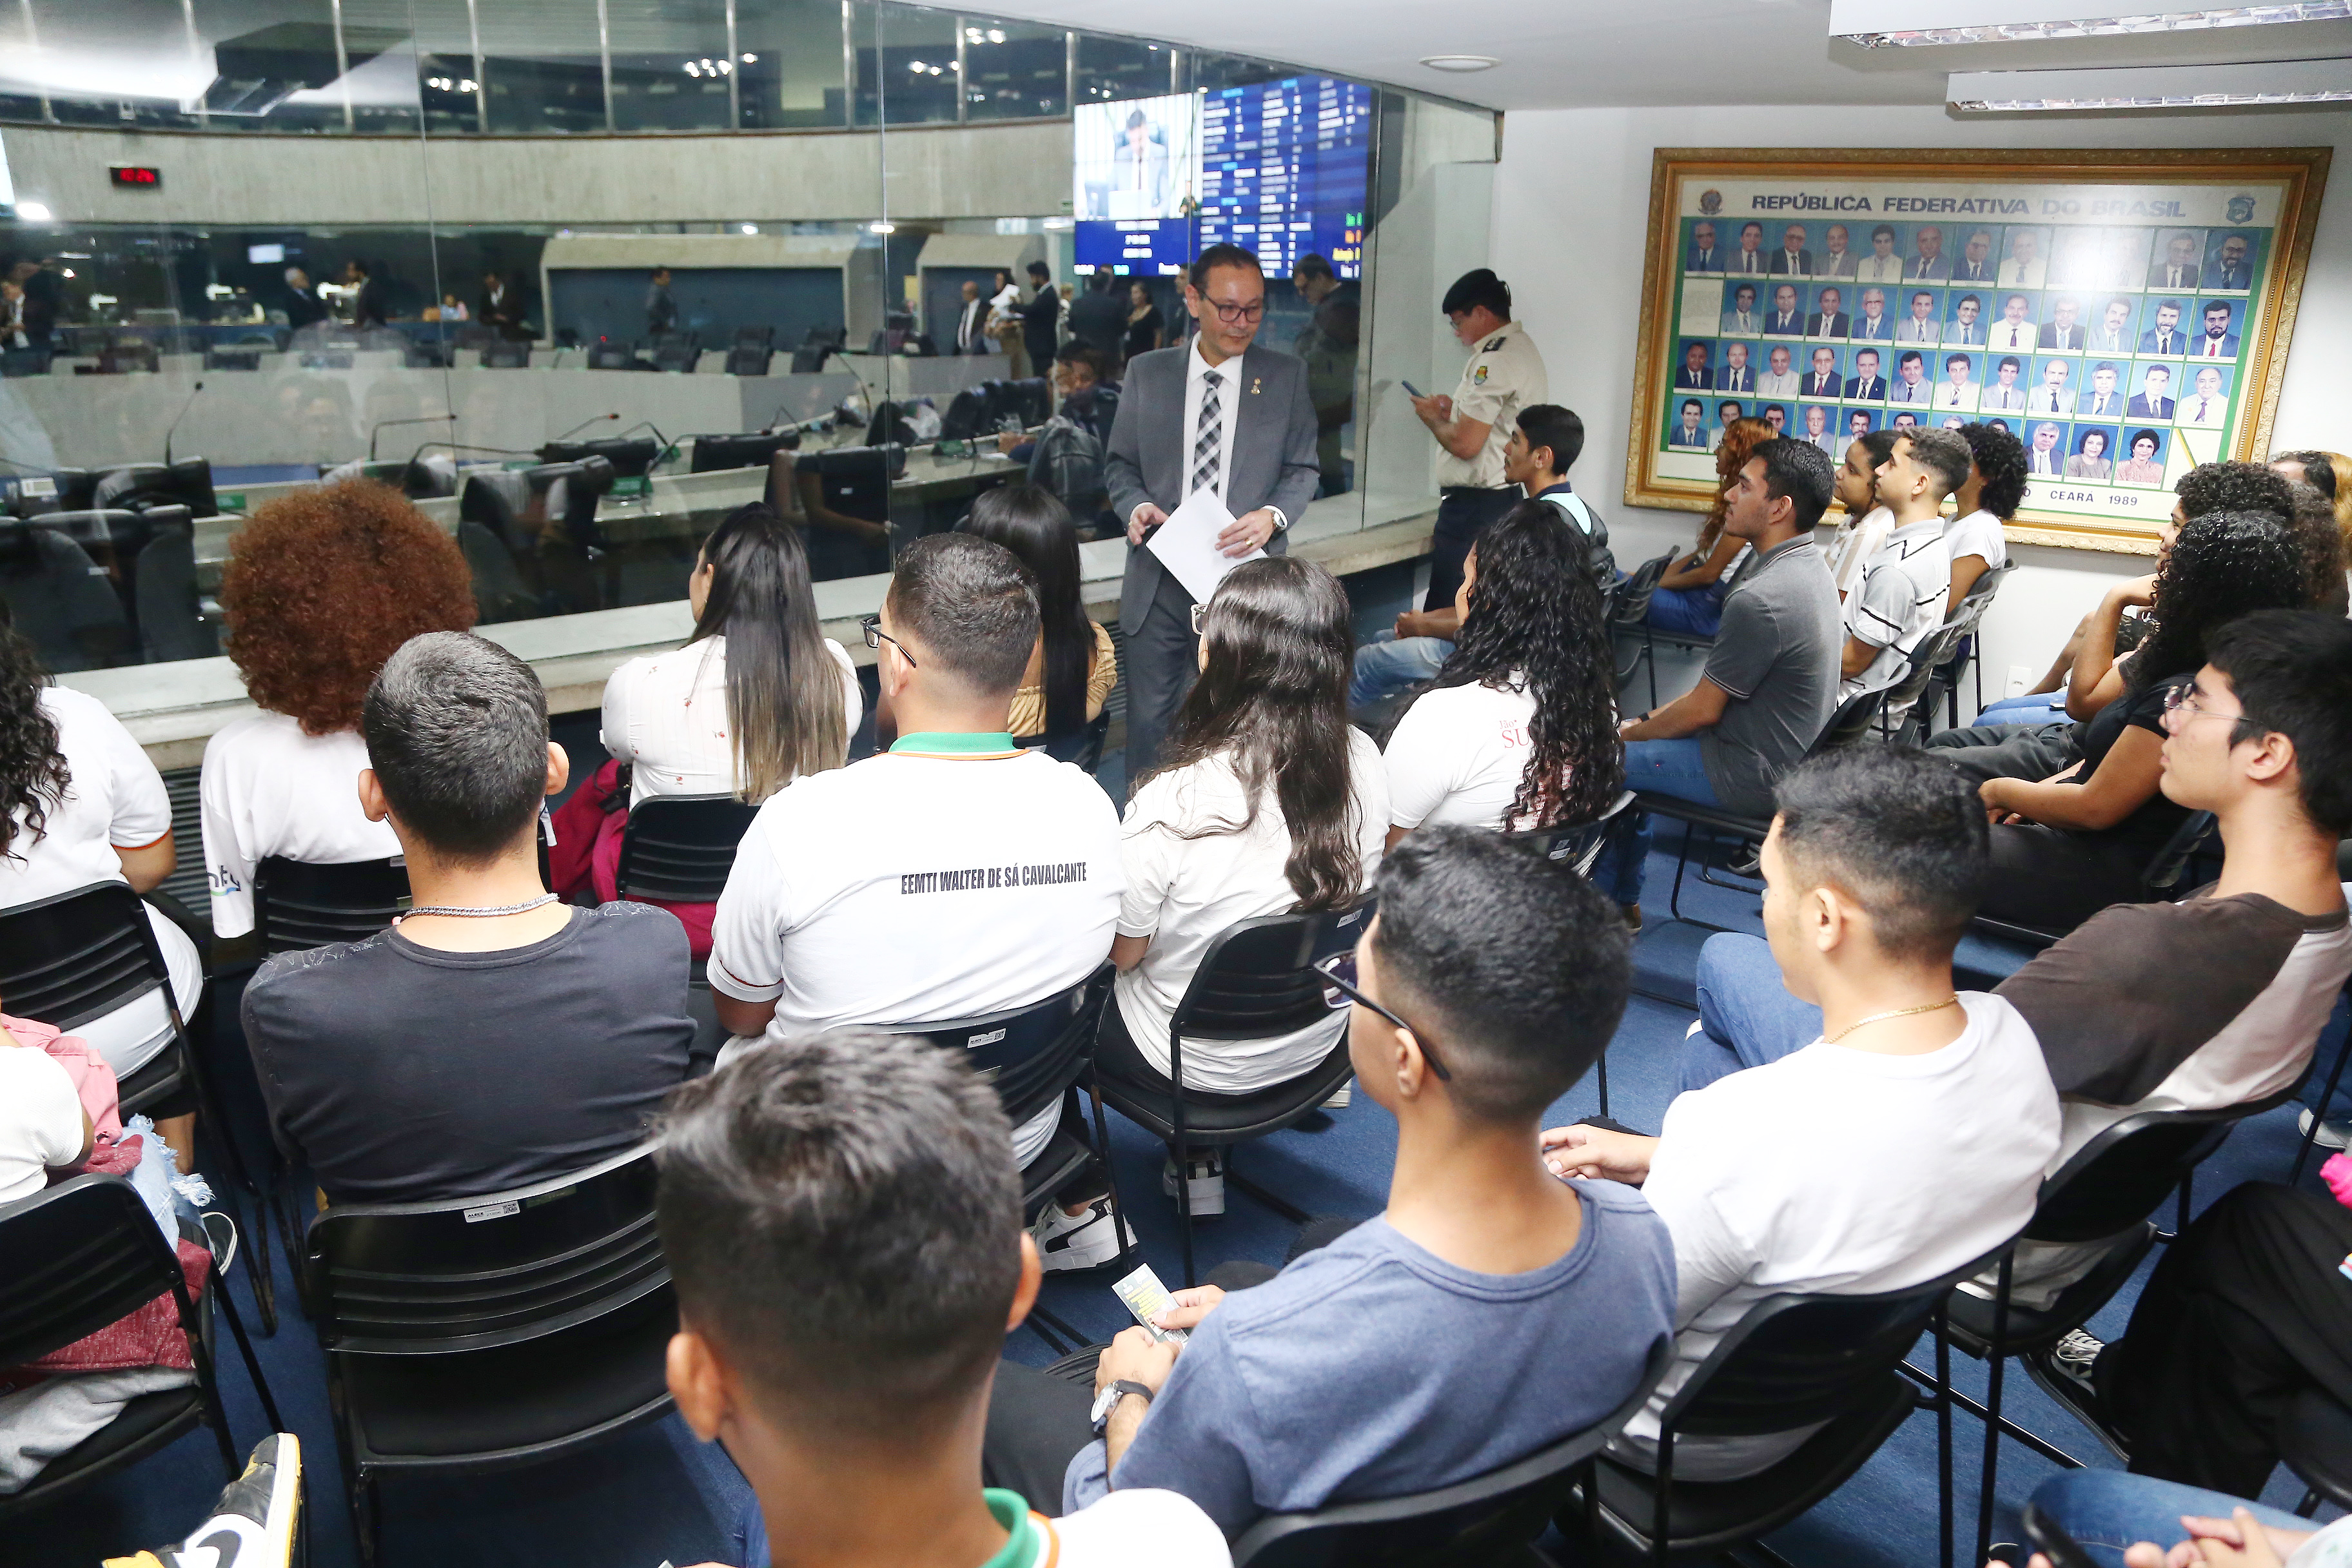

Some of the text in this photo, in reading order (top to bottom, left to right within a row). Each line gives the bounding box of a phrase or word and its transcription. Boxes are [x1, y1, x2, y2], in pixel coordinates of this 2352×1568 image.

[1752, 193, 2186, 218] REPÚBLICA FEDERATIVA DO BRASIL
[2023, 488, 2137, 506] O CEARÁ 1989
[1502, 727, 1529, 749] SU
[901, 862, 1086, 894] EEMTI WALTER DE SÁ CAVALCANTE
